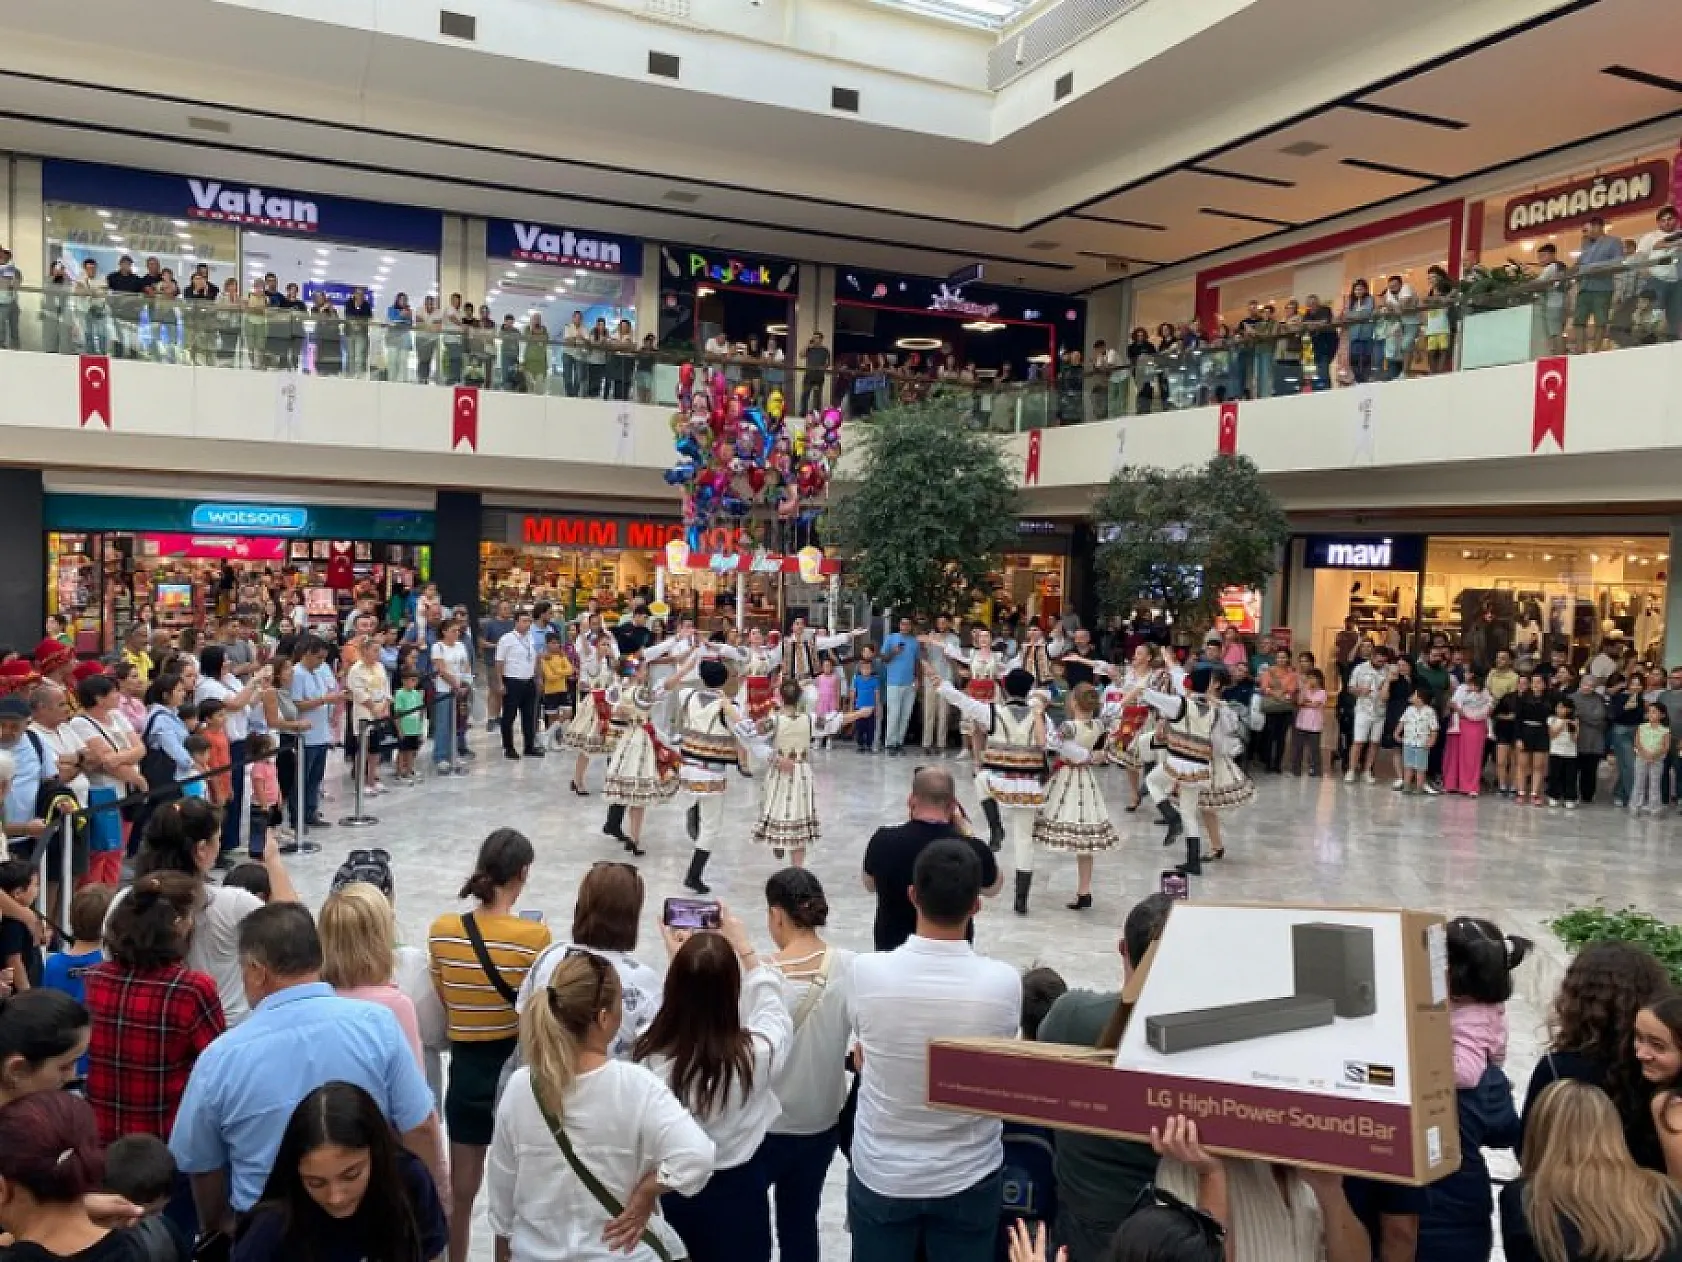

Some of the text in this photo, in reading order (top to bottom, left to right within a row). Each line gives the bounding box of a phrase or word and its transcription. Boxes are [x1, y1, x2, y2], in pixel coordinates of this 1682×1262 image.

[188, 179, 319, 223] Vatan
[1510, 172, 1652, 231] ARMAĞAN
[513, 222, 621, 264] Vatan
[207, 510, 292, 525] watsons
[523, 516, 619, 546] MMM
[1327, 538, 1393, 567] mavi
[1147, 1088, 1397, 1141] LG High Power Sound Bar
